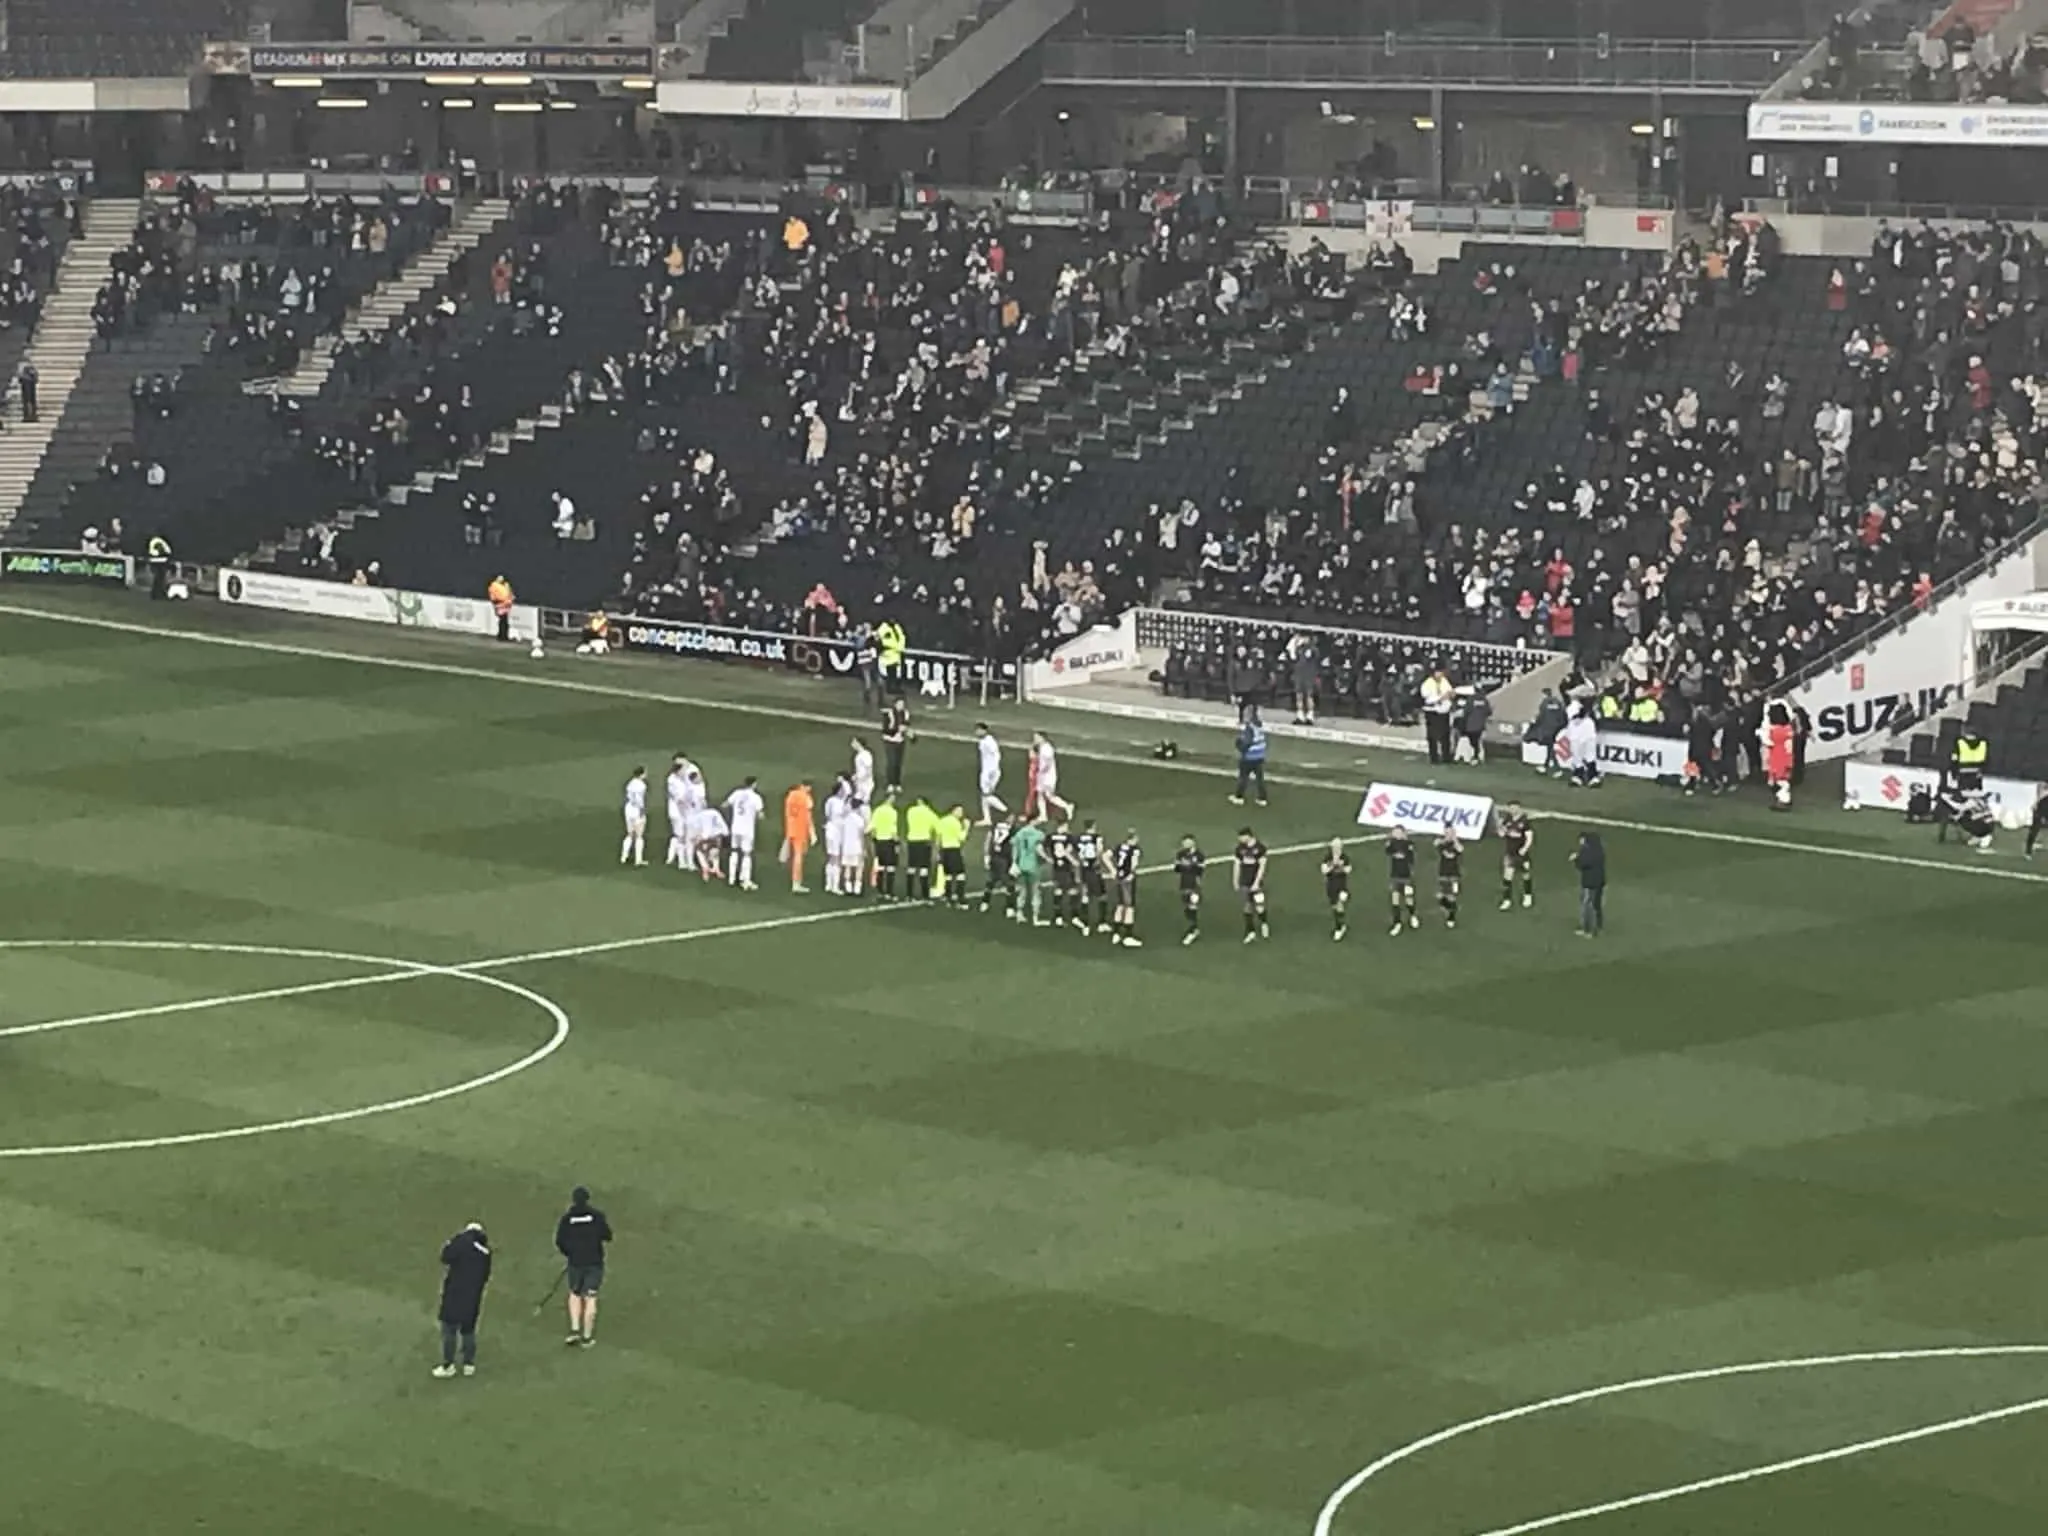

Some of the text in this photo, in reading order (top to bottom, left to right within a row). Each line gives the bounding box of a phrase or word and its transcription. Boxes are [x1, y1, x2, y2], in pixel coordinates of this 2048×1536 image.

[415, 52, 457, 66] LYNX
[629, 627, 786, 661] conceptclean.co.uk
[1069, 649, 1123, 669] SUZUKI
[1596, 743, 1662, 767] UZUKI
[1393, 800, 1482, 827] SUZUKI
